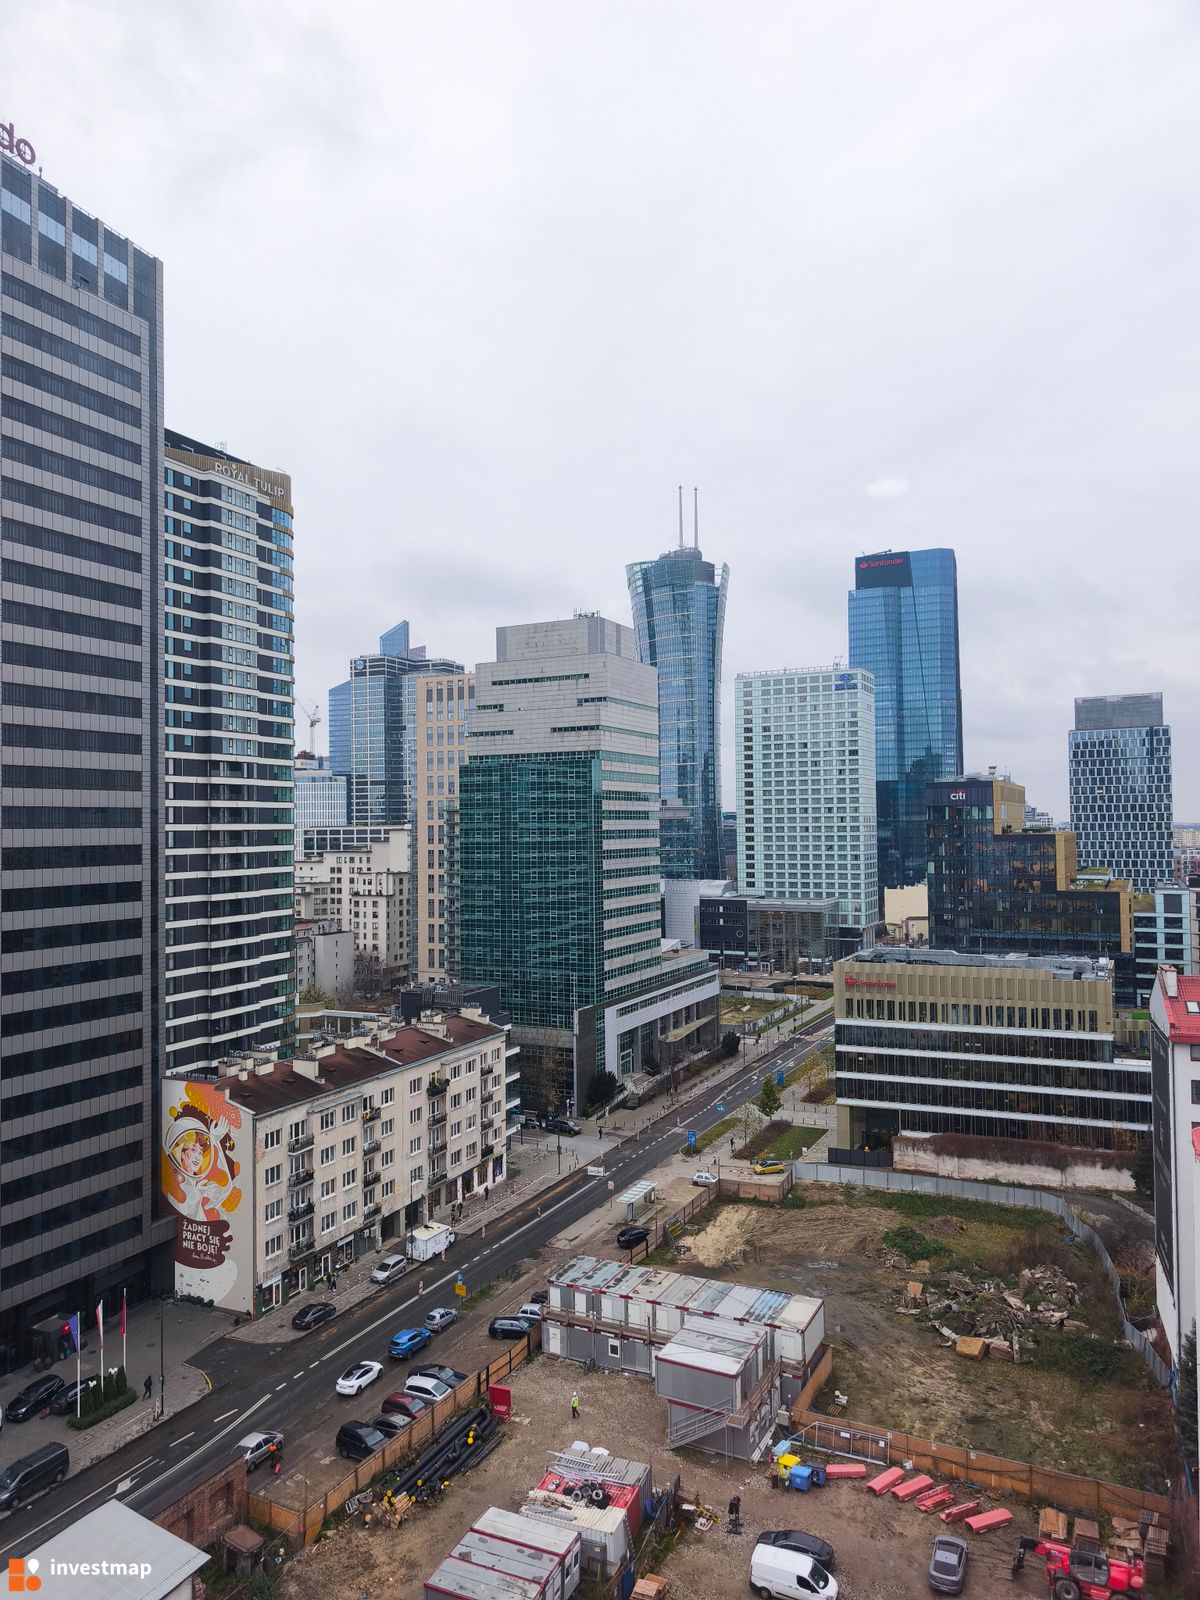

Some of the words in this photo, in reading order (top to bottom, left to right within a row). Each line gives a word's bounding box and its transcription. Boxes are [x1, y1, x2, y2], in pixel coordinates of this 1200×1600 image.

[0, 122, 36, 165] do
[254, 477, 285, 497] TULIP
[869, 557, 904, 568] Santander
[950, 790, 966, 801] citi
[183, 1219, 211, 1236] ŻADNEJ
[183, 1231, 207, 1243] PRACY
[208, 1235, 220, 1247] SIĘ
[183, 1240, 195, 1250] NIE
[197, 1243, 218, 1256] BOJĘ!
